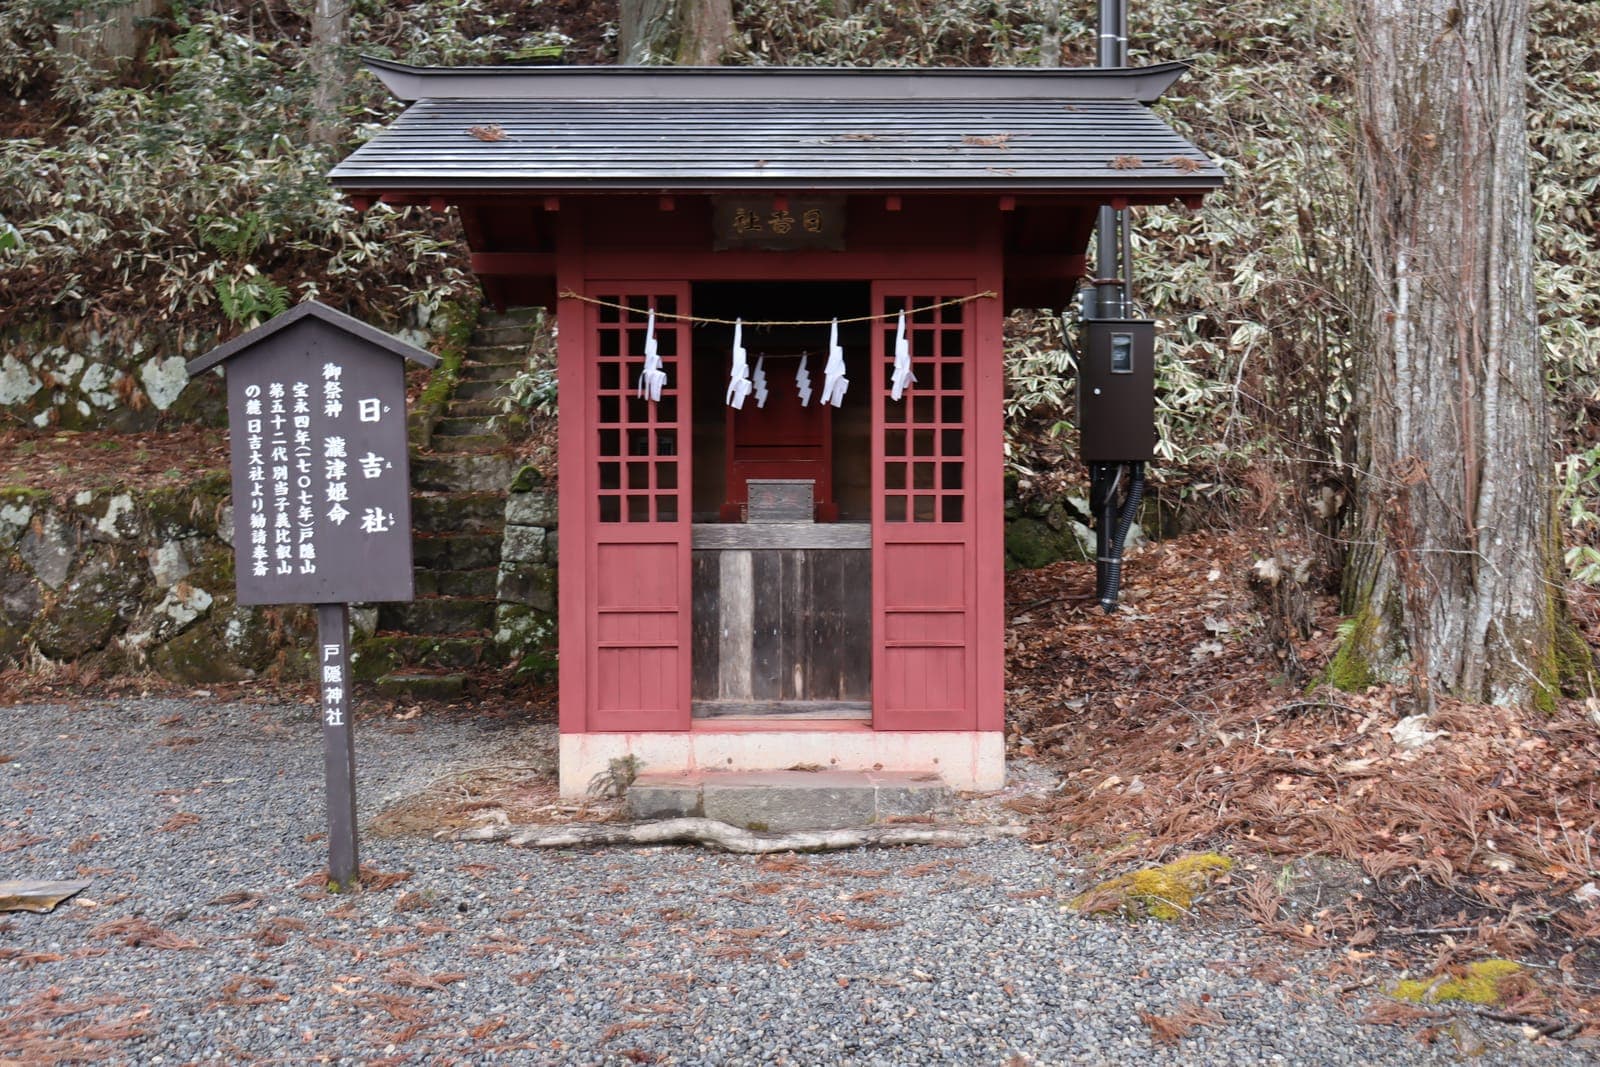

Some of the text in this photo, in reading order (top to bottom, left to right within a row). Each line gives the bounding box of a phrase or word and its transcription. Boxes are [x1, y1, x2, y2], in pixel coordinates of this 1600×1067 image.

[322, 362, 343, 418] 御祭神
[358, 398, 388, 534] 日吉社
[323, 644, 344, 726] 戸隠神社
